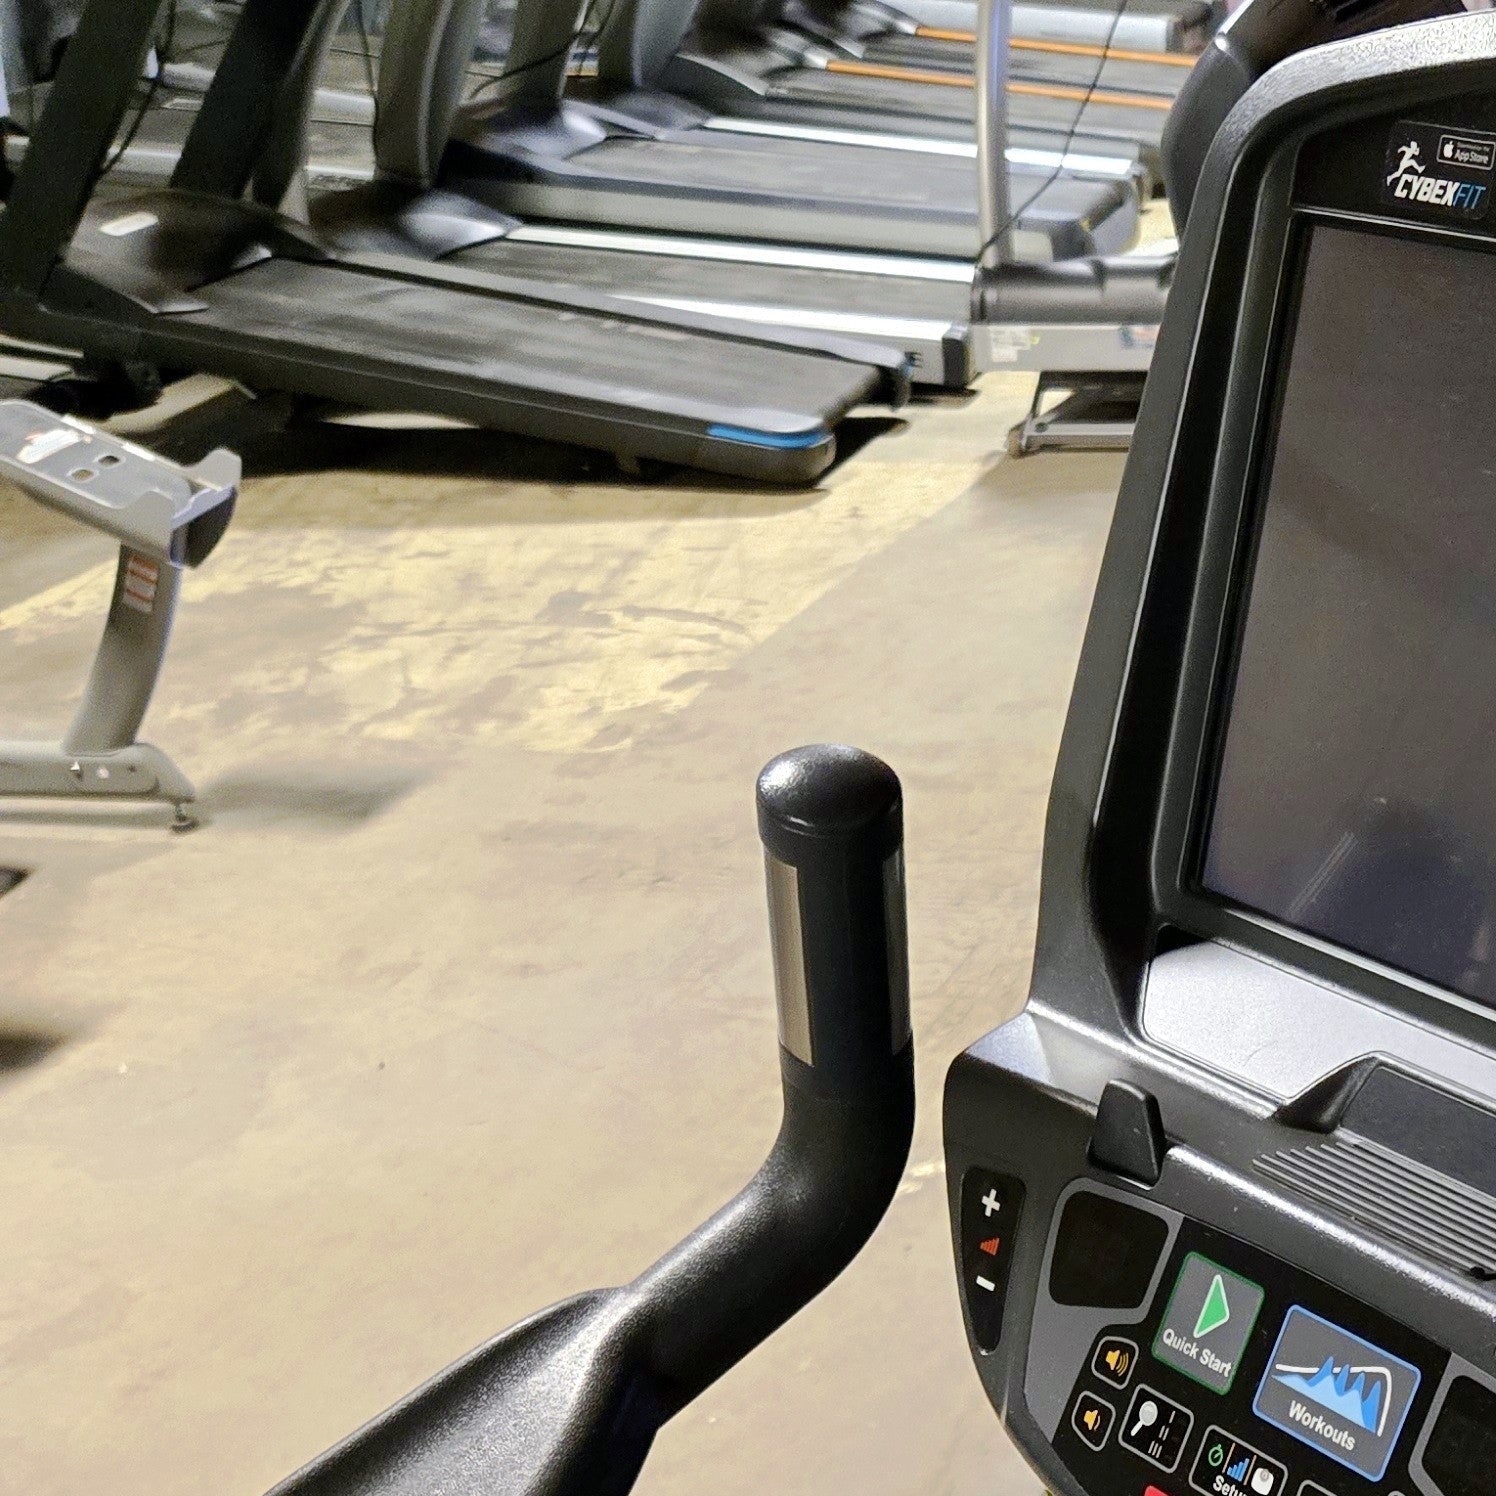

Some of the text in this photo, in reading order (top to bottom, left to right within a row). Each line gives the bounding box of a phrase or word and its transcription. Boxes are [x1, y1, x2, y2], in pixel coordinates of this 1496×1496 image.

[1162, 1328, 1232, 1378] Quick Start
[1288, 1399, 1356, 1452] Workouts
